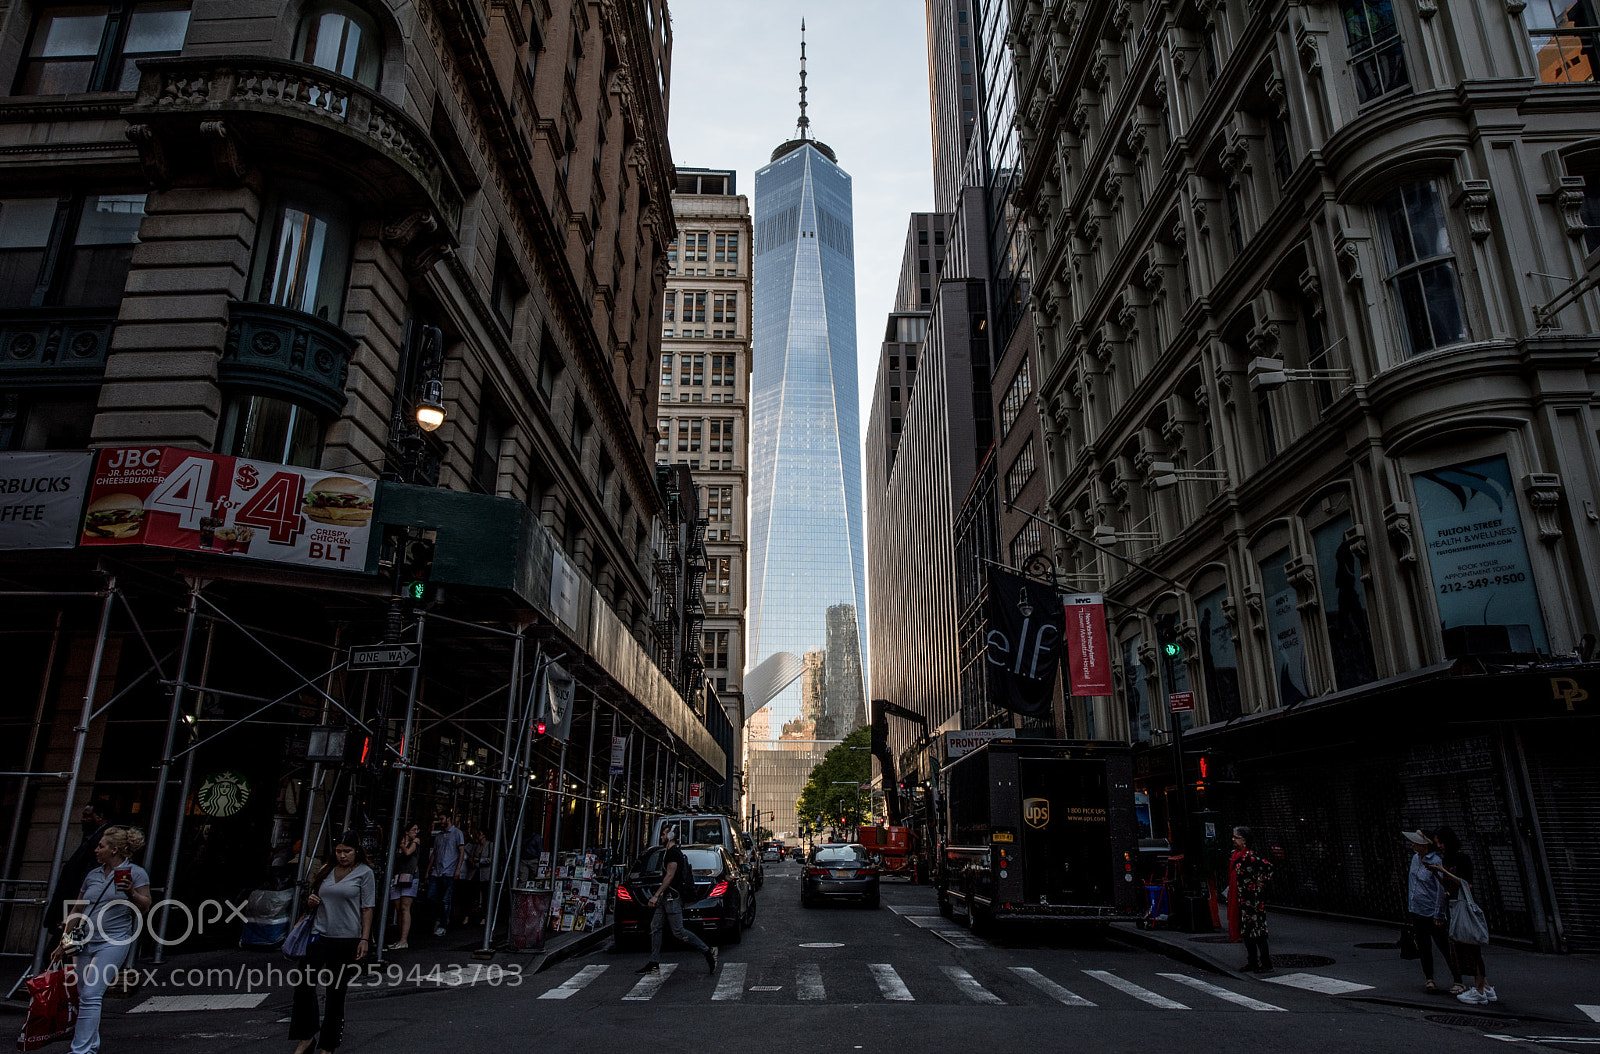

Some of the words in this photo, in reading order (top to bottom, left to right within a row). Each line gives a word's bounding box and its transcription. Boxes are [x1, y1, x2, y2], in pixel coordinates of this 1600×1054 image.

[108, 449, 161, 468] JBC
[107, 469, 121, 477] JR.
[123, 468, 155, 477] BACON
[96, 476, 166, 485] CHEESEBURGER
[142, 456, 214, 531] 4
[213, 495, 242, 512] for
[315, 527, 348, 538] CRISPY
[1438, 525, 1471, 537] FULTON
[1473, 519, 1502, 531] STREET
[310, 533, 351, 544] CHICKEN
[1429, 536, 1462, 549] HEALTH
[309, 541, 351, 562] BLT
[1444, 568, 1491, 580] APPOINTMENT
[1493, 563, 1515, 573] TODAY
[1457, 562, 1477, 571] BOOK
[1479, 559, 1498, 568] YOUR
[1440, 572, 1526, 594] 212-349-9500
[359, 652, 379, 662] ONE
[388, 651, 410, 661] WAY
[949, 737, 985, 748] PRONTO
[1026, 807, 1048, 825] ups
